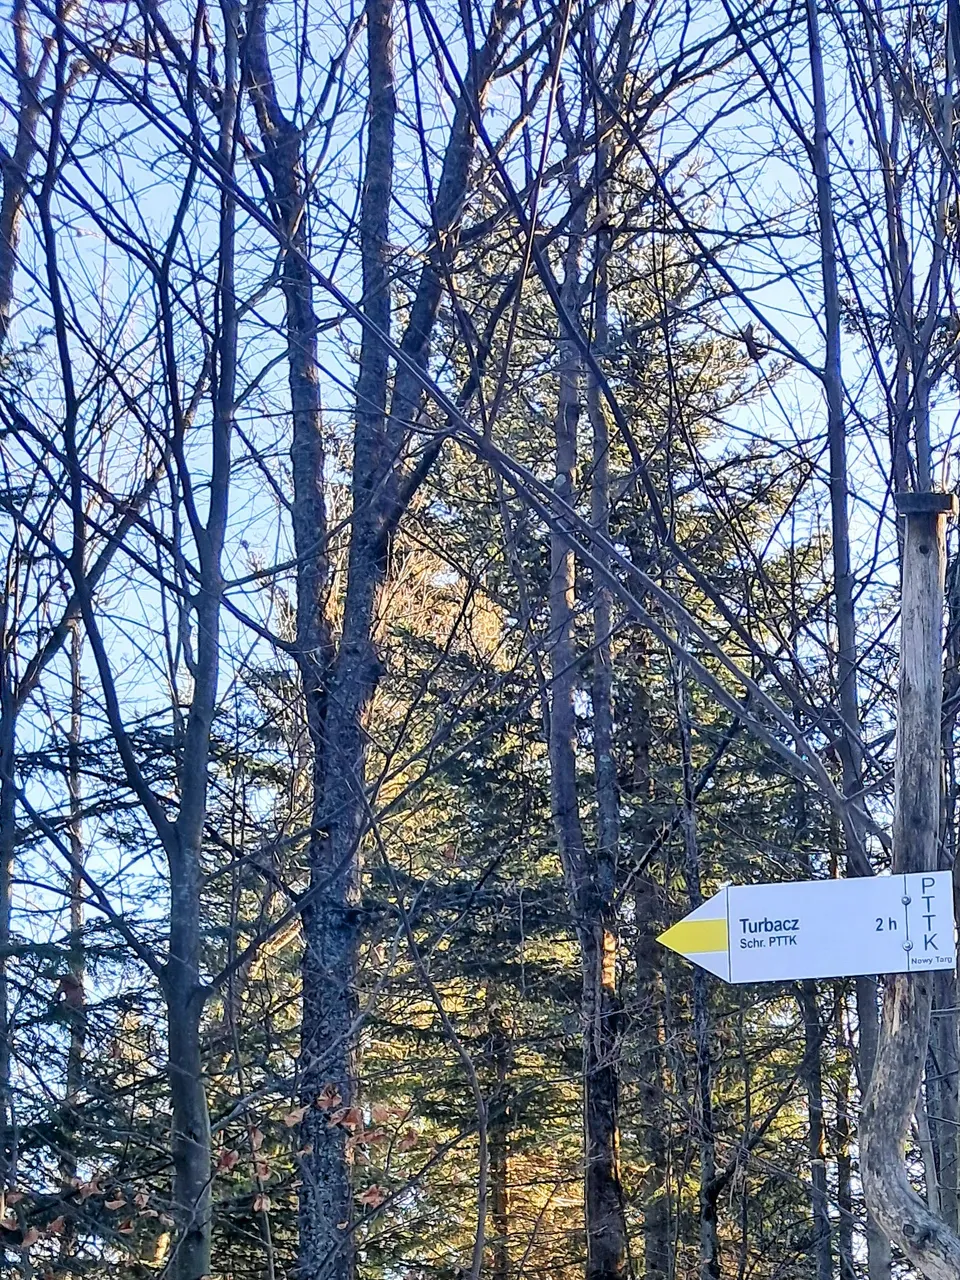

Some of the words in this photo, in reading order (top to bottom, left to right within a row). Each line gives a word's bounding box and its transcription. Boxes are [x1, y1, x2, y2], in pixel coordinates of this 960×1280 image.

[921, 877, 939, 951] PTTK
[739, 918, 800, 933] Turbacz
[875, 918, 885, 932] 2
[888, 917, 897, 931] h
[739, 938, 766, 949] Schr.
[769, 935, 798, 947] PTTK
[911, 957, 934, 966] Nowy
[935, 956, 953, 965] Targ
